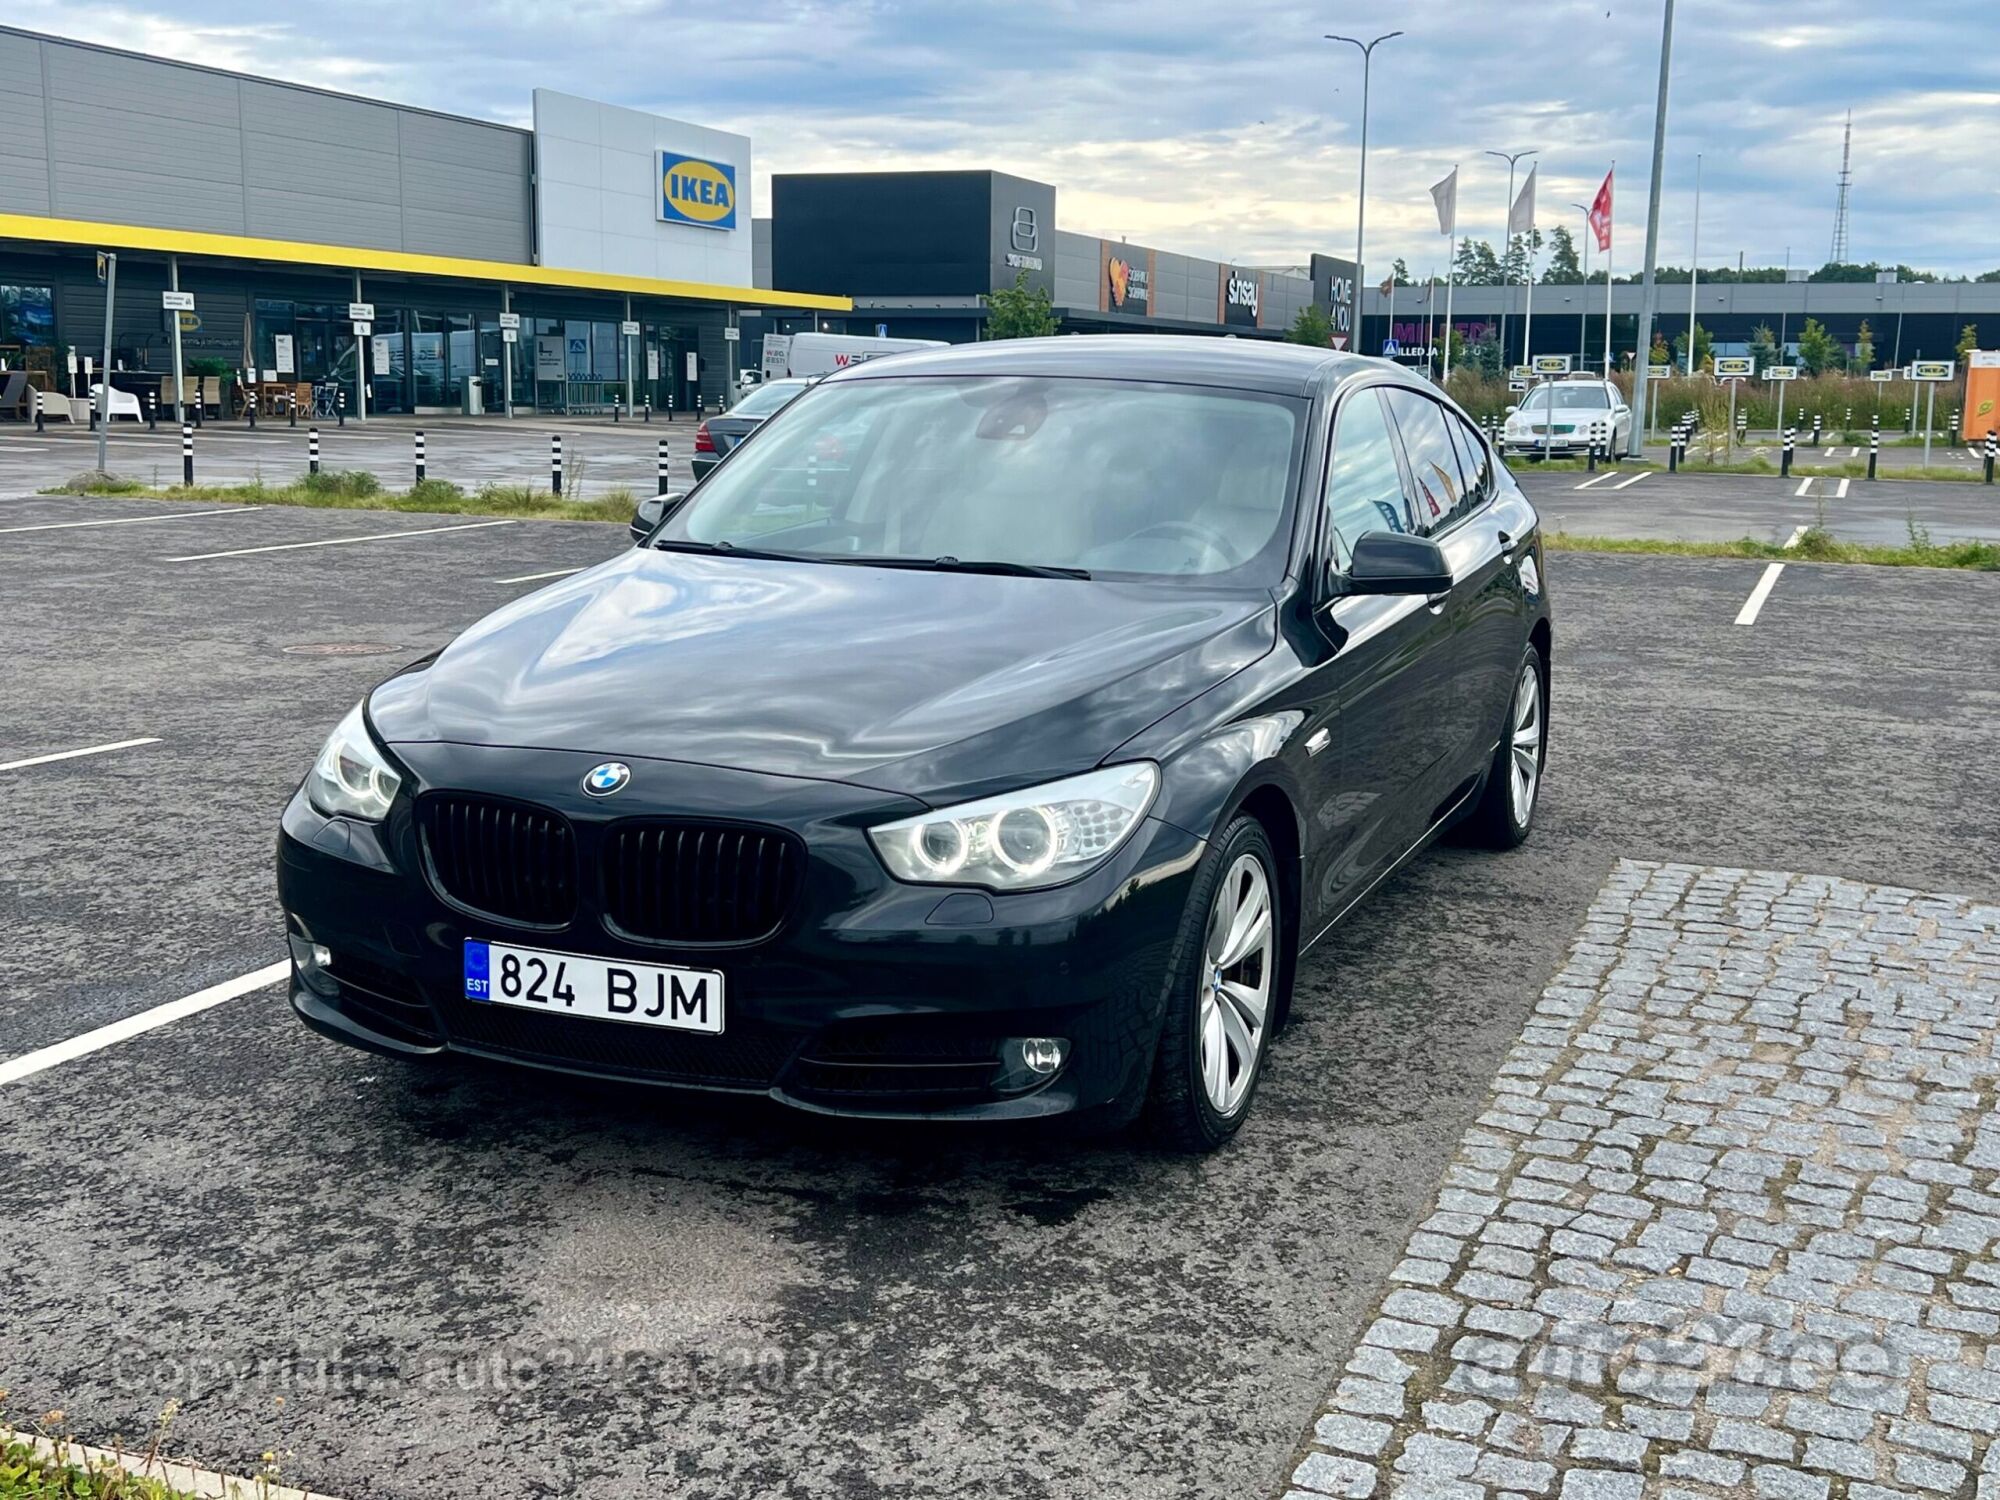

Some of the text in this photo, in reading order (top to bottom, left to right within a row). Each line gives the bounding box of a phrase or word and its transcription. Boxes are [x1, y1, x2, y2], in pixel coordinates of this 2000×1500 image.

[671, 173, 730, 208] IKEA
[1228, 270, 1259, 317] sinsay
[1331, 275, 1352, 304] HOME
[467, 978, 489, 993] EST
[501, 953, 708, 1024] 824 BJM
